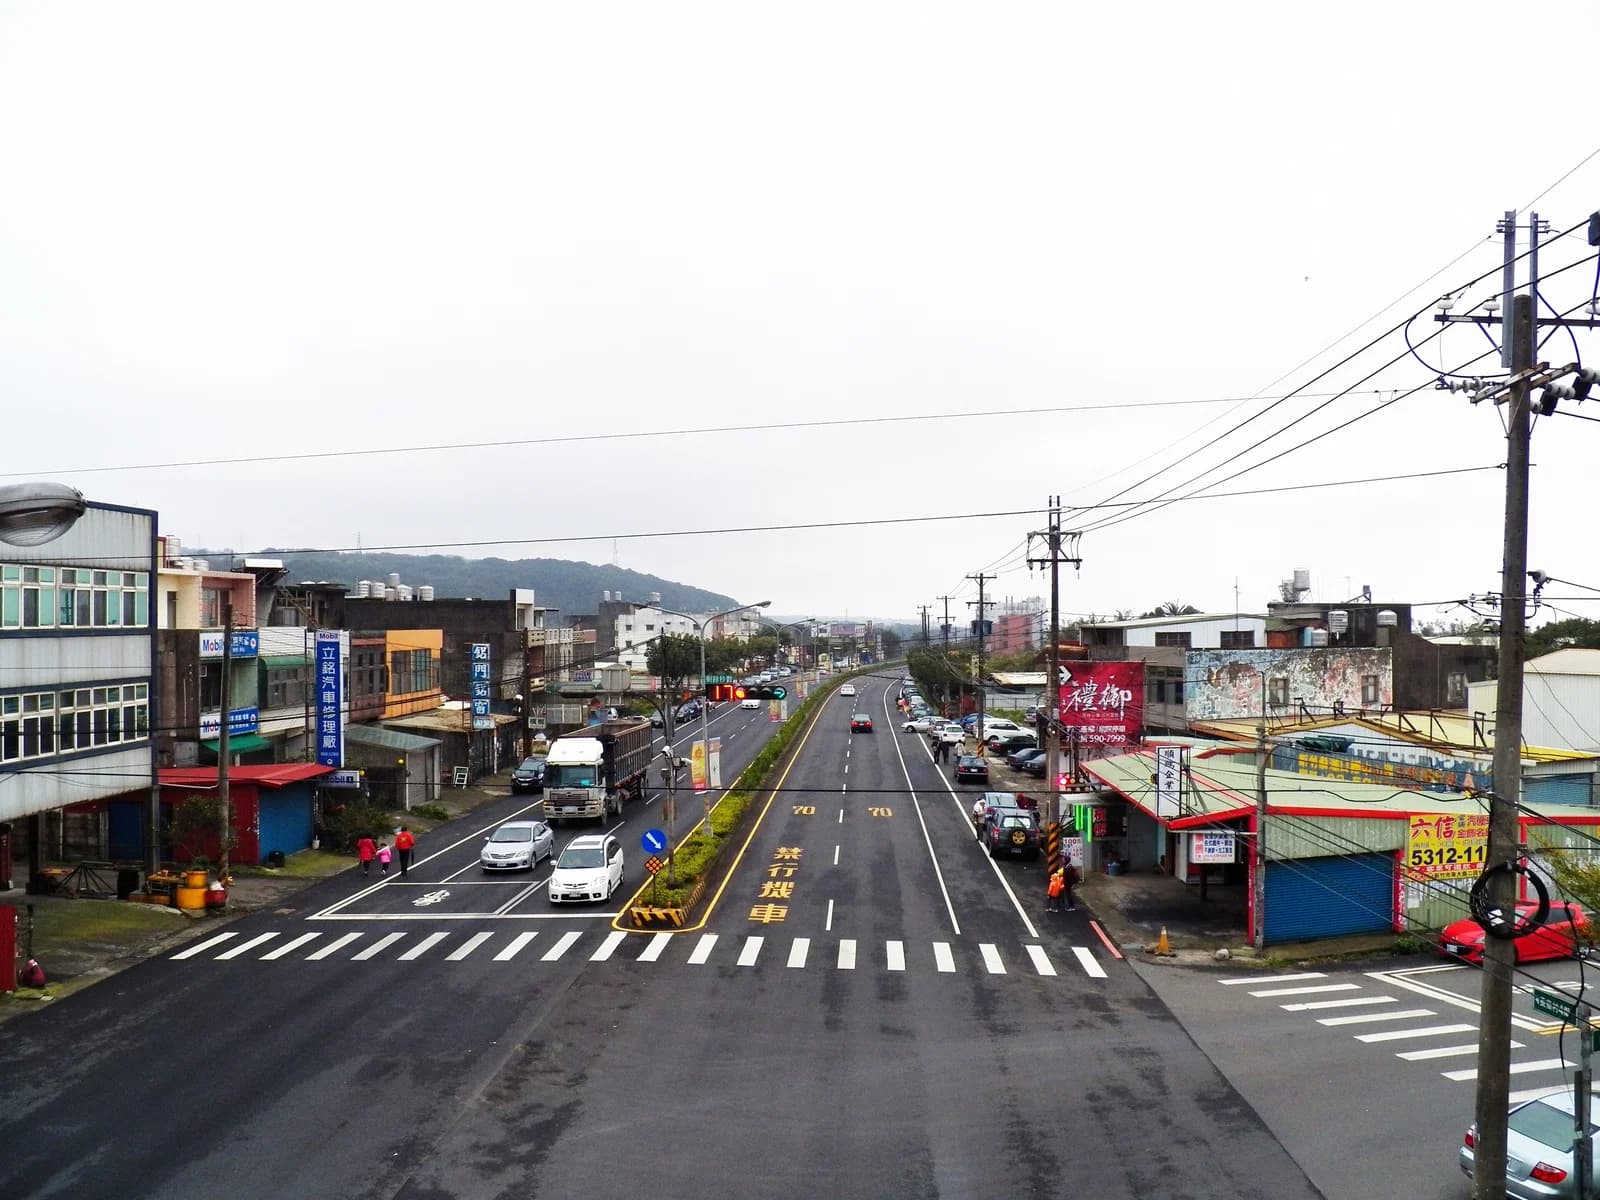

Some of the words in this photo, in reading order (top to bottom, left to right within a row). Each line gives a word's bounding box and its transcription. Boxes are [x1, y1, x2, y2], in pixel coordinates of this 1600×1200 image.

[319, 632, 339, 640] Mobil
[321, 646, 337, 749] 立銘汽車修理廠
[714, 684, 734, 700] 17
[792, 805, 816, 815] 70
[868, 807, 893, 817] 70
[1411, 816, 1456, 840] 六信
[1411, 845, 1487, 866] 5312-11
[747, 847, 803, 924] 禁行機車
